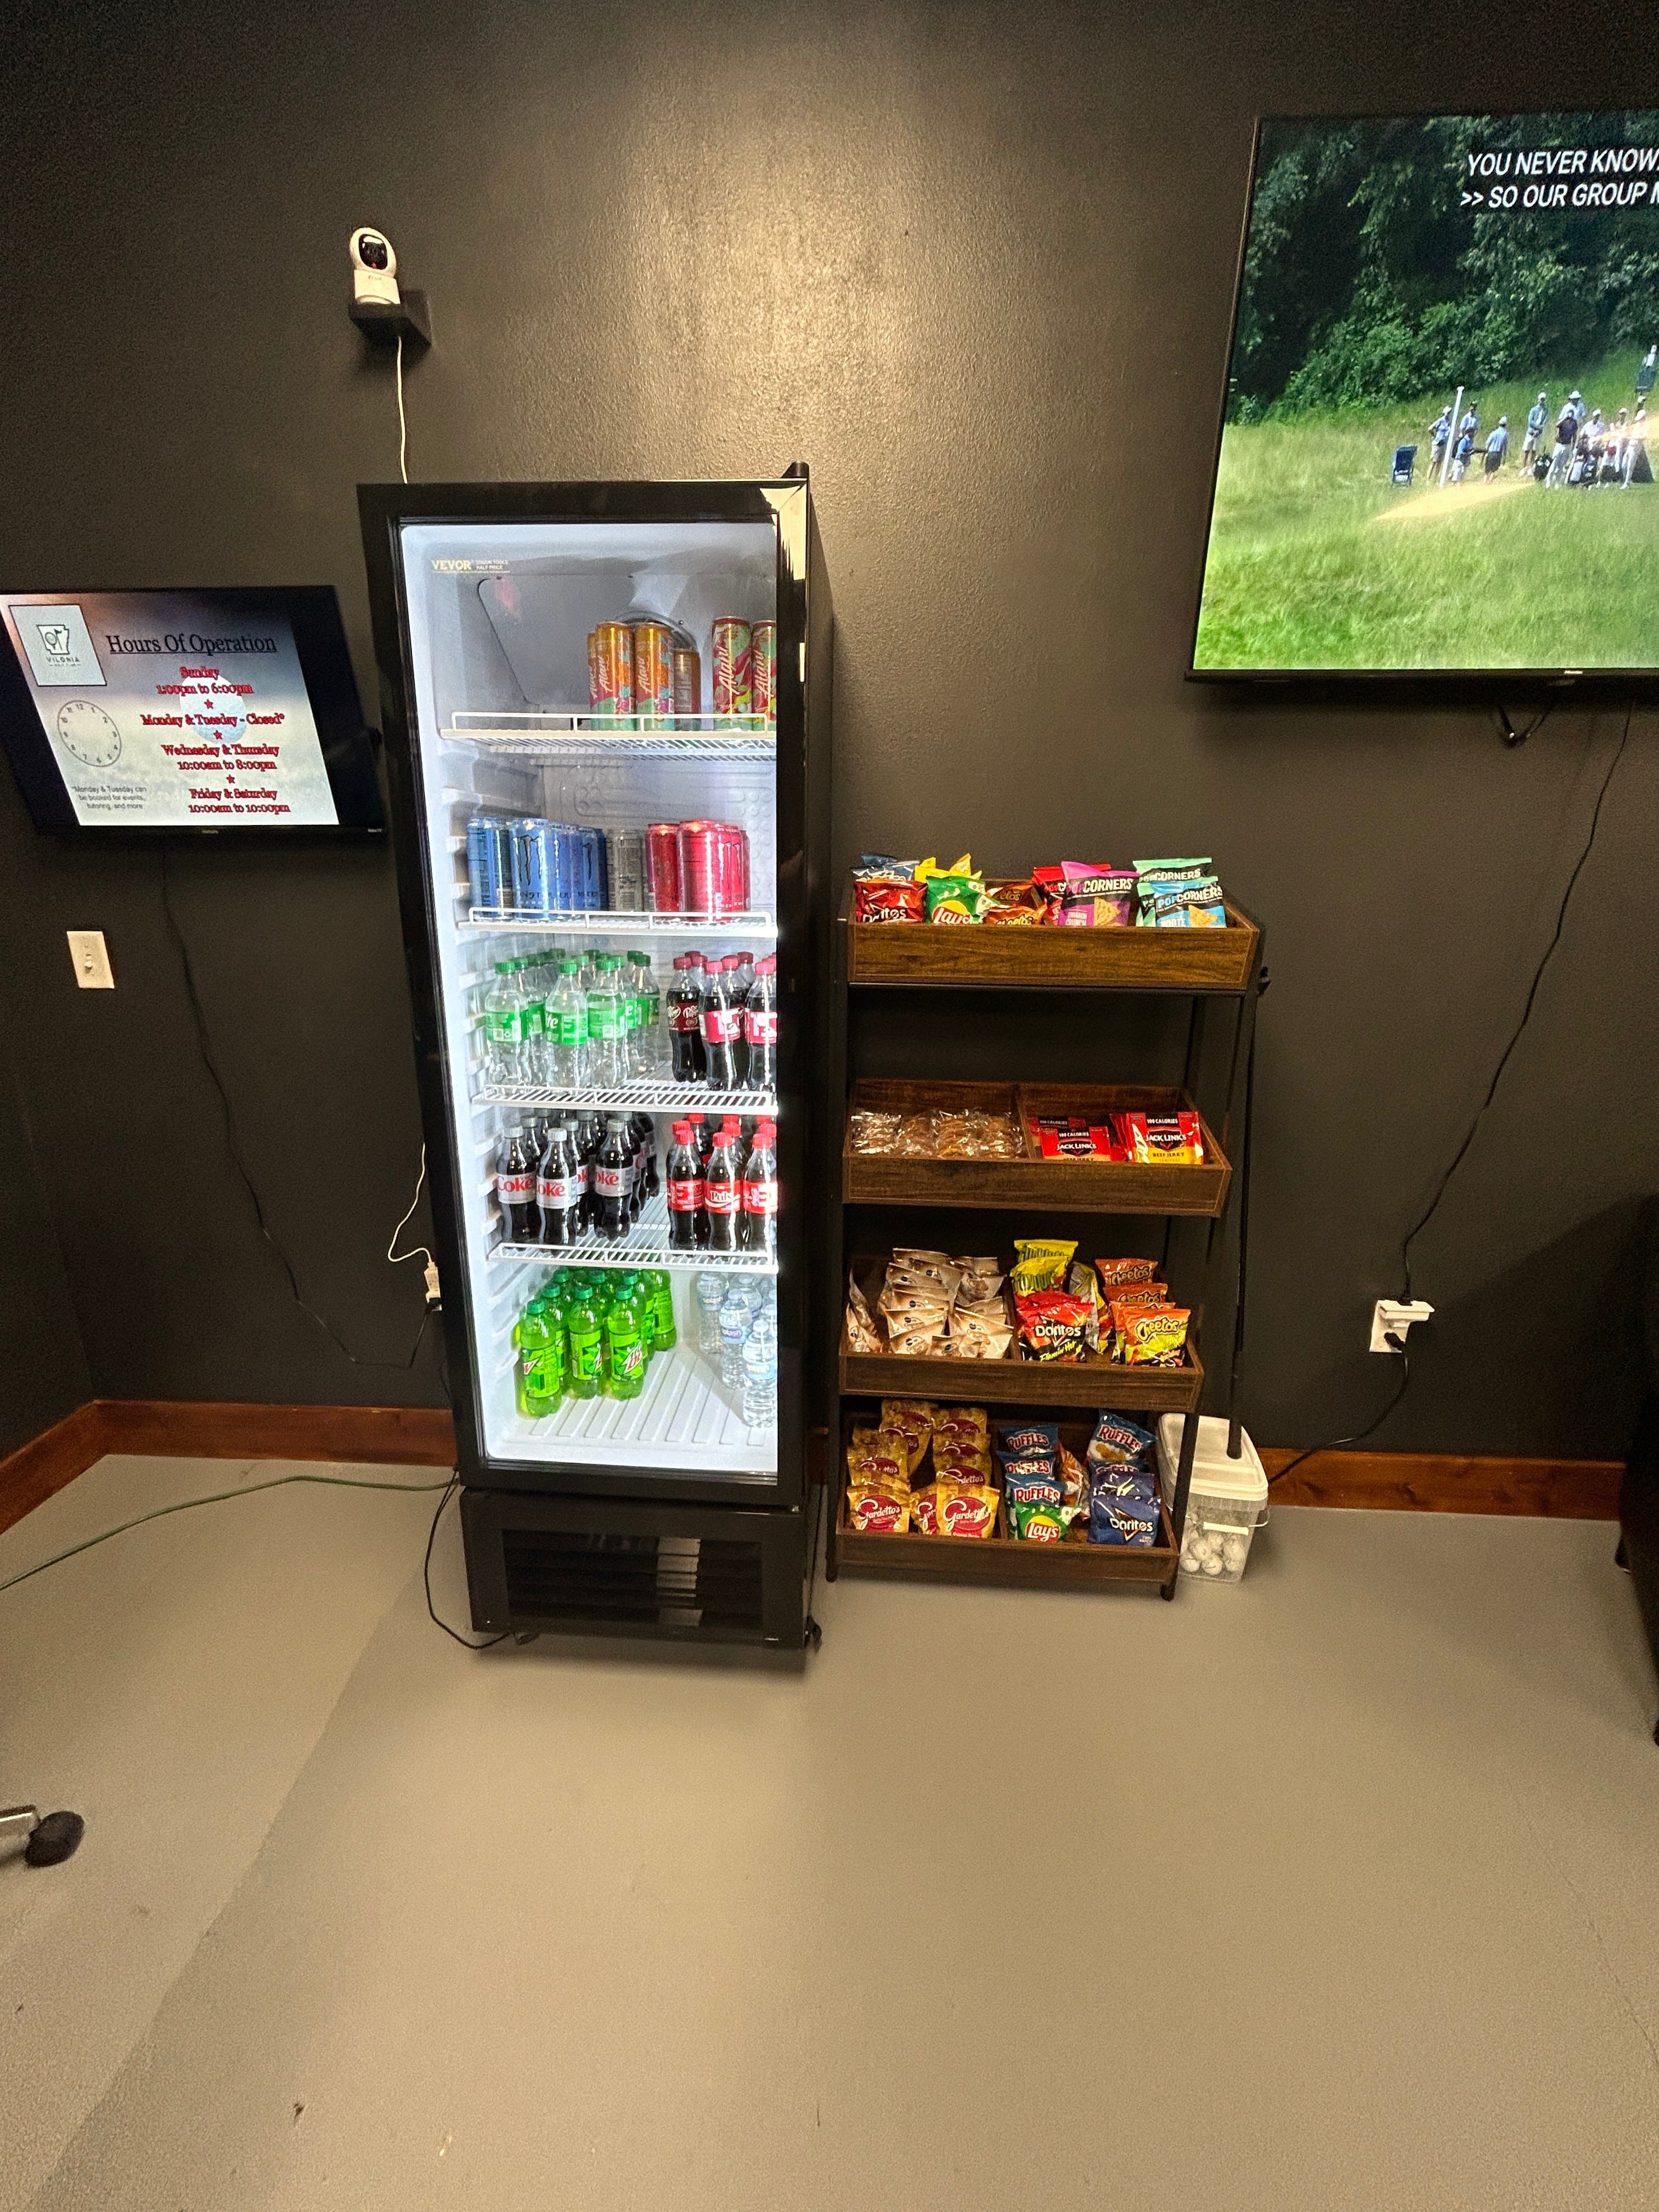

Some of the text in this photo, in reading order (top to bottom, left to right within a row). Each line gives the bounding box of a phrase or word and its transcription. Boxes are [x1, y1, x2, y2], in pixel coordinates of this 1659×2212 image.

[1468, 153, 1512, 176] YOU
[1515, 150, 1587, 174] NEVER
[1488, 186, 1518, 208] SO
[1523, 184, 1568, 207] OUR
[1572, 182, 1647, 206] GROUP
[431, 560, 471, 570] VEVOR
[106, 633, 276, 655] Hours Of Operation
[180, 666, 219, 680] Sunday
[597, 655, 613, 693] Alani
[637, 656, 653, 694] Alani
[716, 645, 740, 697] Alani
[754, 649, 775, 698] Alani
[156, 682, 253, 696] 1:00pm to 6:00pm
[140, 714, 183, 727] Monday
[185, 714, 194, 725] &
[194, 714, 238, 726] Tuesday
[161, 744, 279, 757] Wednesday & Thursday
[177, 759, 277, 771] 10:00am to 8:00pm
[189, 788, 278, 800] Friday & Saturday
[189, 804, 291, 815] 10:00am to 10:00pm
[497, 1176, 534, 1192] Coke
[595, 1171, 619, 1186] oke
[537, 1182, 566, 1197] oke
[1110, 1265, 1151, 1285] Cheetos
[1035, 1324, 1081, 1337] Doritos
[1136, 1316, 1180, 1343] Cheetos
[1007, 1432, 1049, 1452] RUFFLES
[1097, 1424, 1142, 1453] RUFFLES
[1015, 1486, 1060, 1503] RUFFLES
[857, 1499, 901, 1531] Gardetto's
[1110, 1517, 1153, 1532] Doritos
